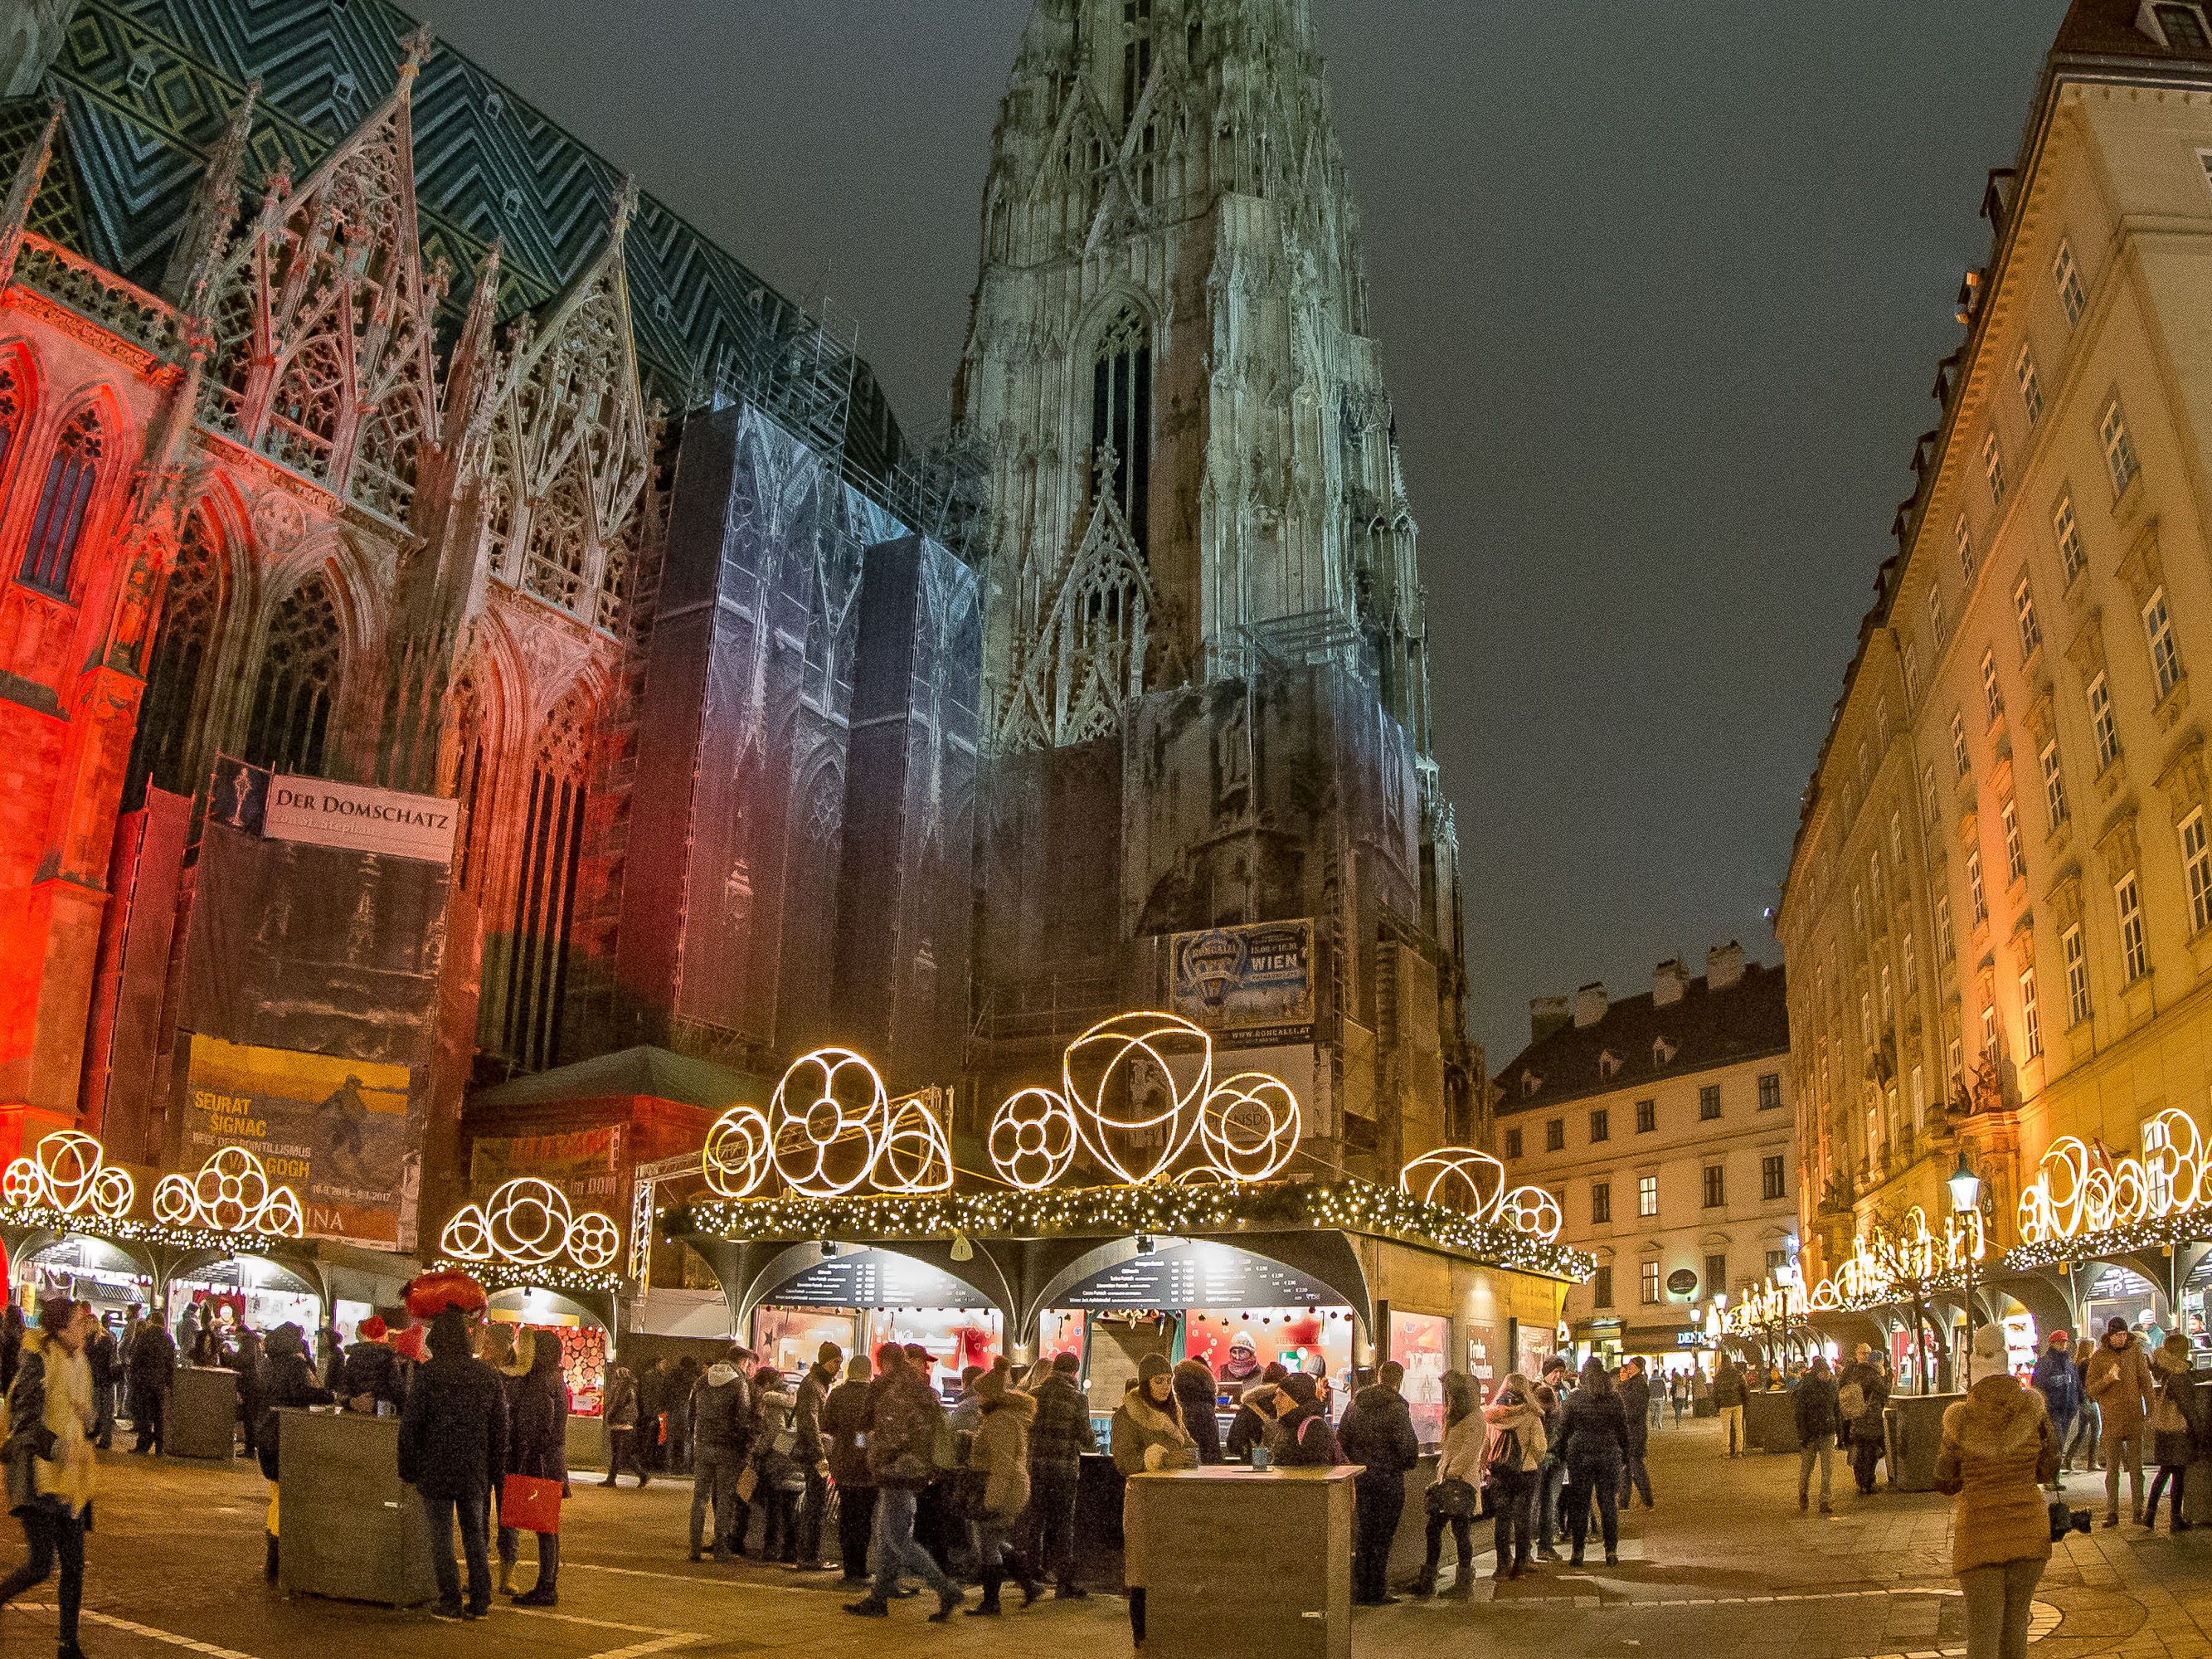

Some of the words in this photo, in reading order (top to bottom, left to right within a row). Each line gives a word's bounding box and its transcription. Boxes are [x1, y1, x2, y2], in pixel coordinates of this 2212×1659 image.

[276, 789, 316, 810] DER
[323, 795, 449, 830] DOMSCHATZ
[1251, 953, 1297, 971] WIEN
[194, 1091, 251, 1116] SEURAT
[209, 1112, 267, 1138] SIGNAC
[265, 1157, 310, 1179] GOGH
